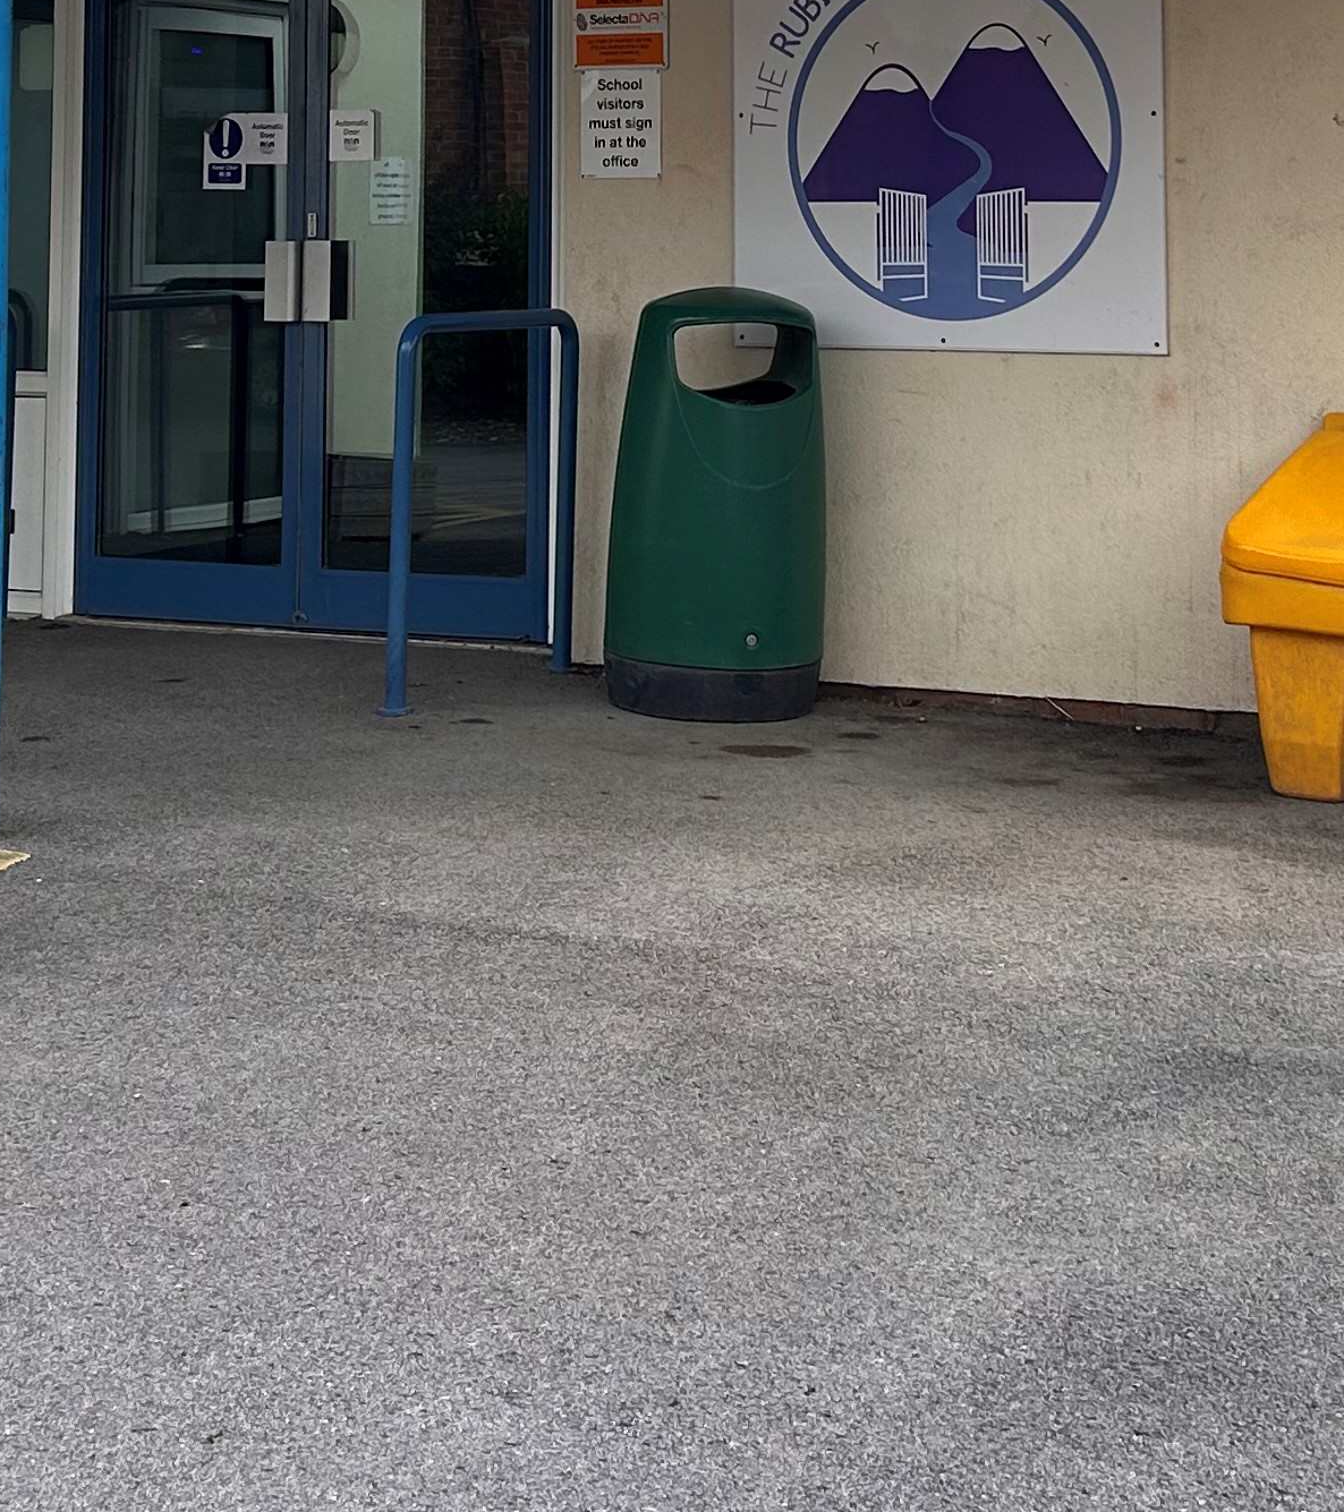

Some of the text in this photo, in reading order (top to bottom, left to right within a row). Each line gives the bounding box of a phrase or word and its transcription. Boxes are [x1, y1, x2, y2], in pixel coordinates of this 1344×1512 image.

[597, 78, 643, 91] School
[596, 97, 644, 110] visitors
[749, 61, 789, 135] THE
[588, 117, 653, 131] must sign
[594, 135, 647, 148] in at the
[602, 155, 639, 167] office
